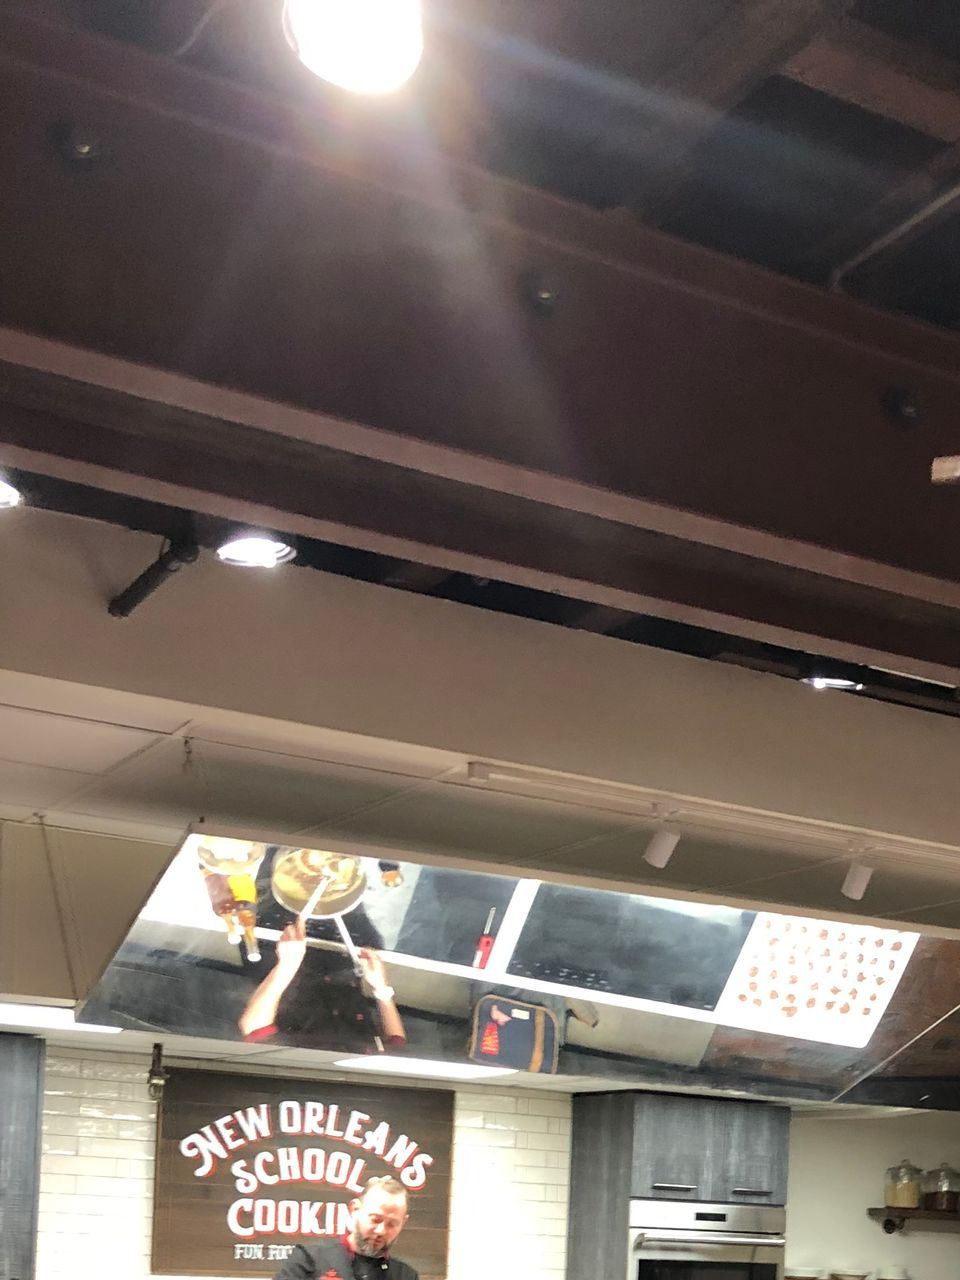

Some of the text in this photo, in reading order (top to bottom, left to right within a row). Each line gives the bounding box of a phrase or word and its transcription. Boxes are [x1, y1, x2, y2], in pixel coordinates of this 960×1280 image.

[180, 1101, 434, 1188] NEW ORLEANS
[231, 1147, 368, 1194] SCHOOL
[227, 1198, 355, 1236] COOKIN
